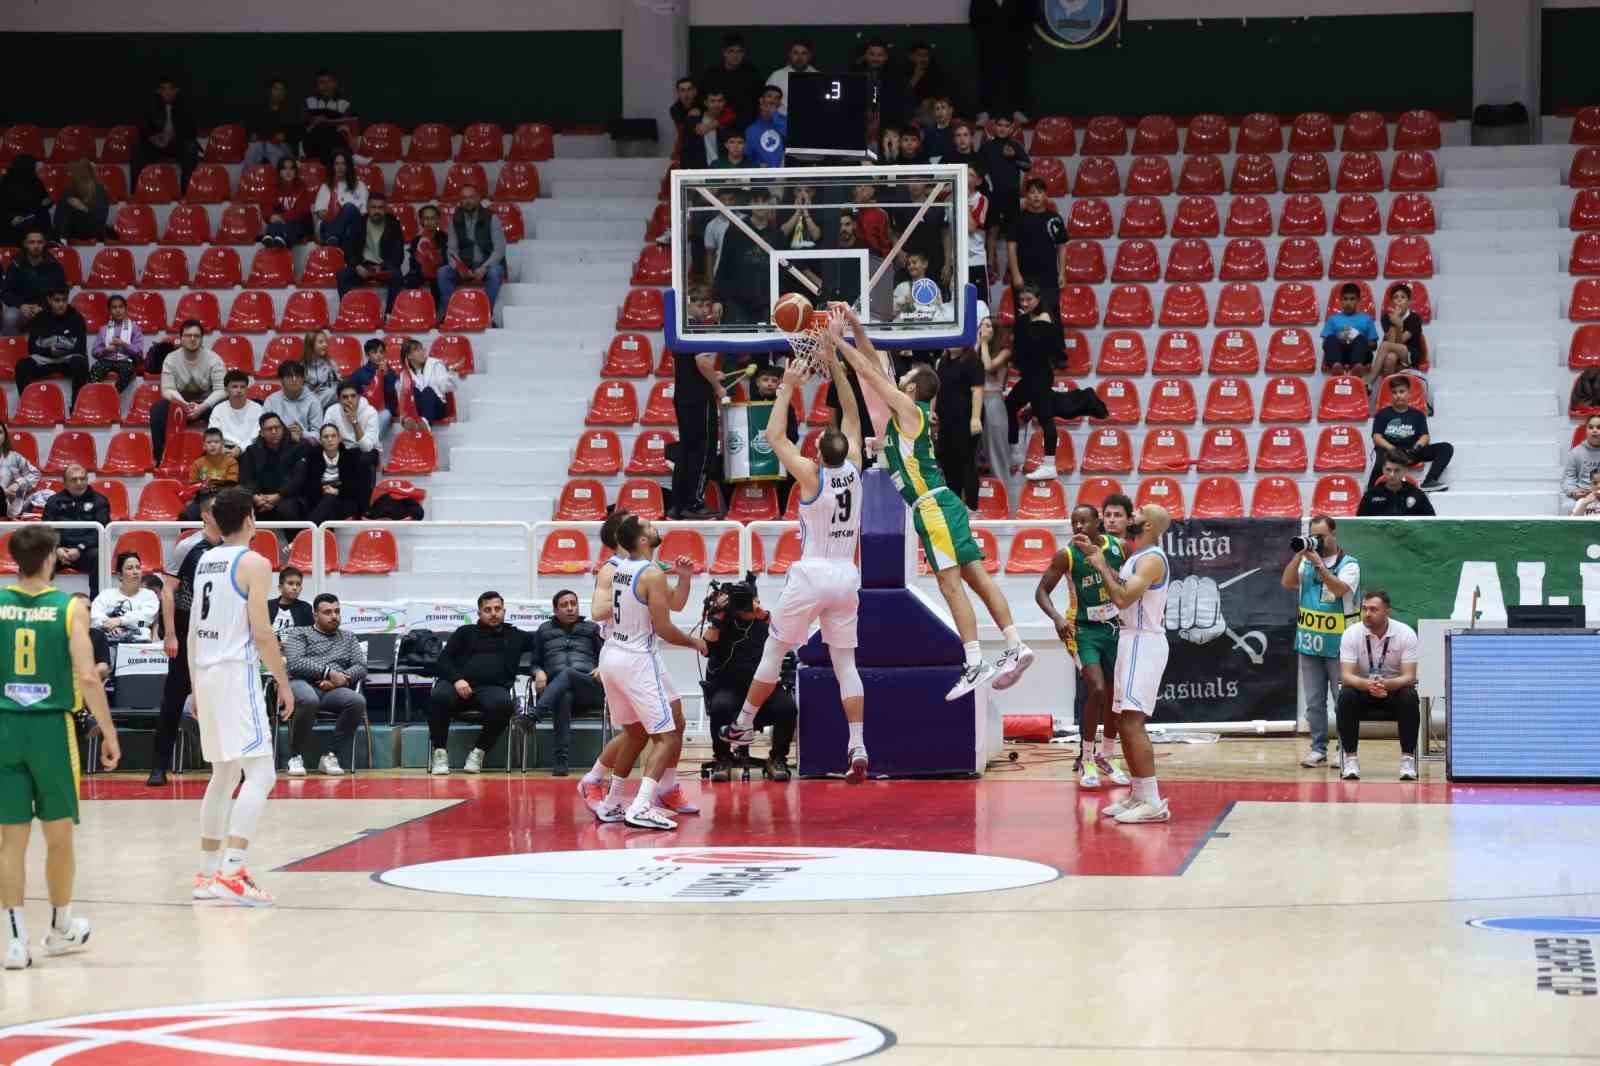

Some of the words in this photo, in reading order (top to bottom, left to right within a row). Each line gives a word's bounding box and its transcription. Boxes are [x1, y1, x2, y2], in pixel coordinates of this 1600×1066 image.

[825, 80, 840, 99] .3
[1160, 530, 1231, 561] liağa
[201, 581, 213, 620] 6
[614, 590, 622, 624] 5
[15, 628, 36, 675] 8
